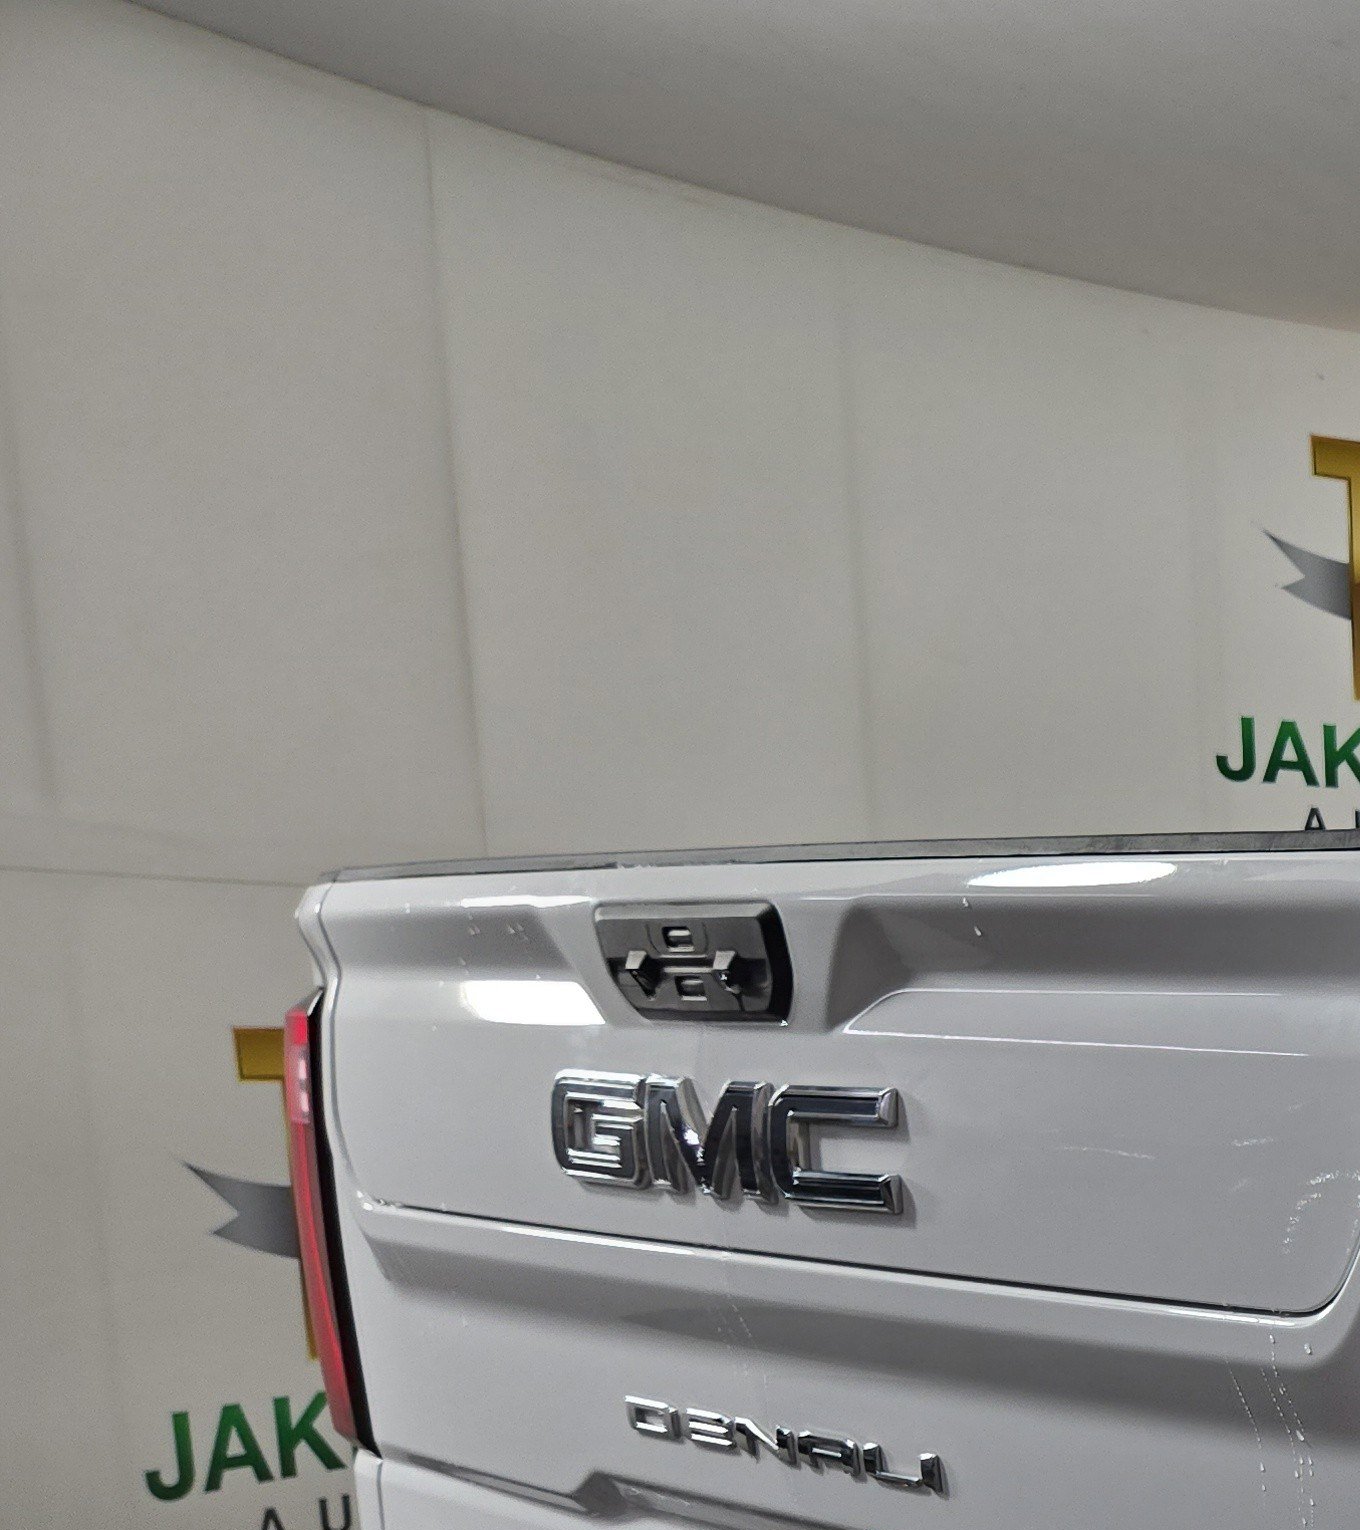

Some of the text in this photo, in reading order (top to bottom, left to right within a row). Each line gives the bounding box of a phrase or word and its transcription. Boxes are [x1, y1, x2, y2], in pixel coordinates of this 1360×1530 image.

[551, 1068, 904, 1214] GMC
[144, 1390, 347, 1502] JAK
[624, 1394, 947, 1495] DENALI
